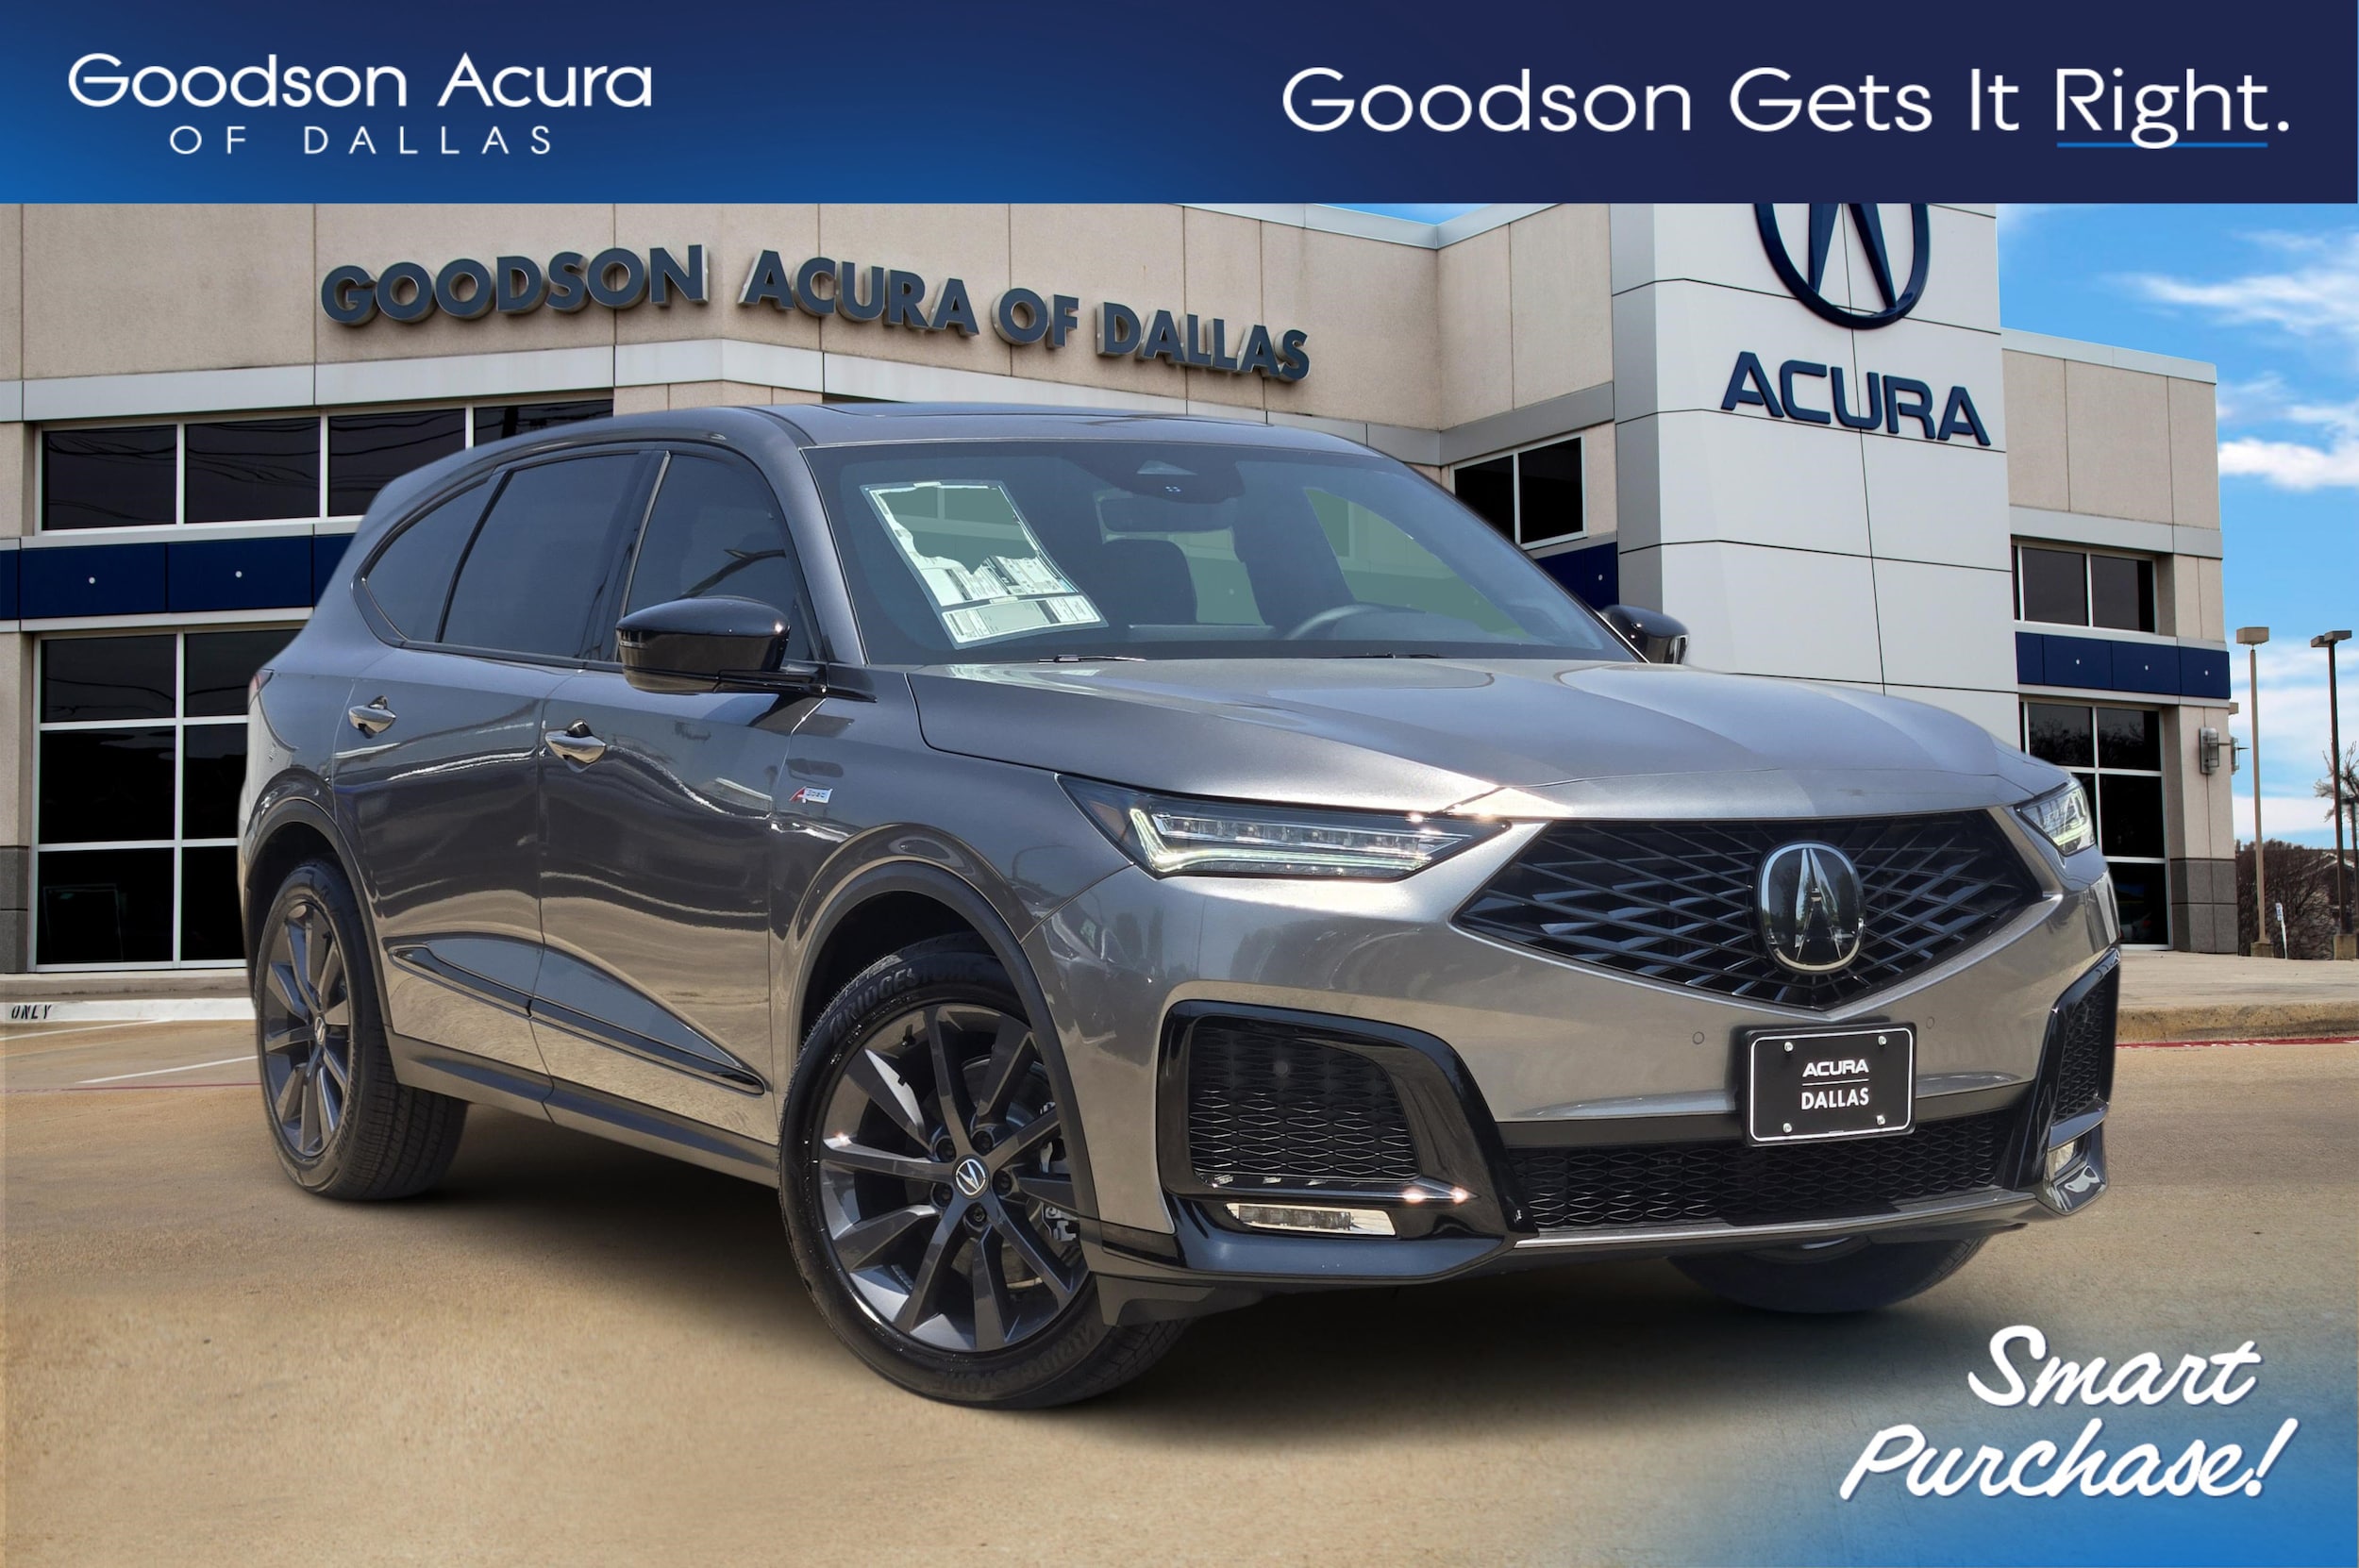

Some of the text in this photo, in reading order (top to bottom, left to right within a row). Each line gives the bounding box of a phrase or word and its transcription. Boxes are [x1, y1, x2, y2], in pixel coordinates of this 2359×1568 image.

[321, 244, 1311, 382] GOODSON ACURA OF DALLAS
[1720, 350, 1992, 447] ACURA
[10, 1004, 53, 1020] ONLY
[1801, 1059, 1870, 1077] ACURA
[1800, 1087, 1870, 1110] DALLAS
